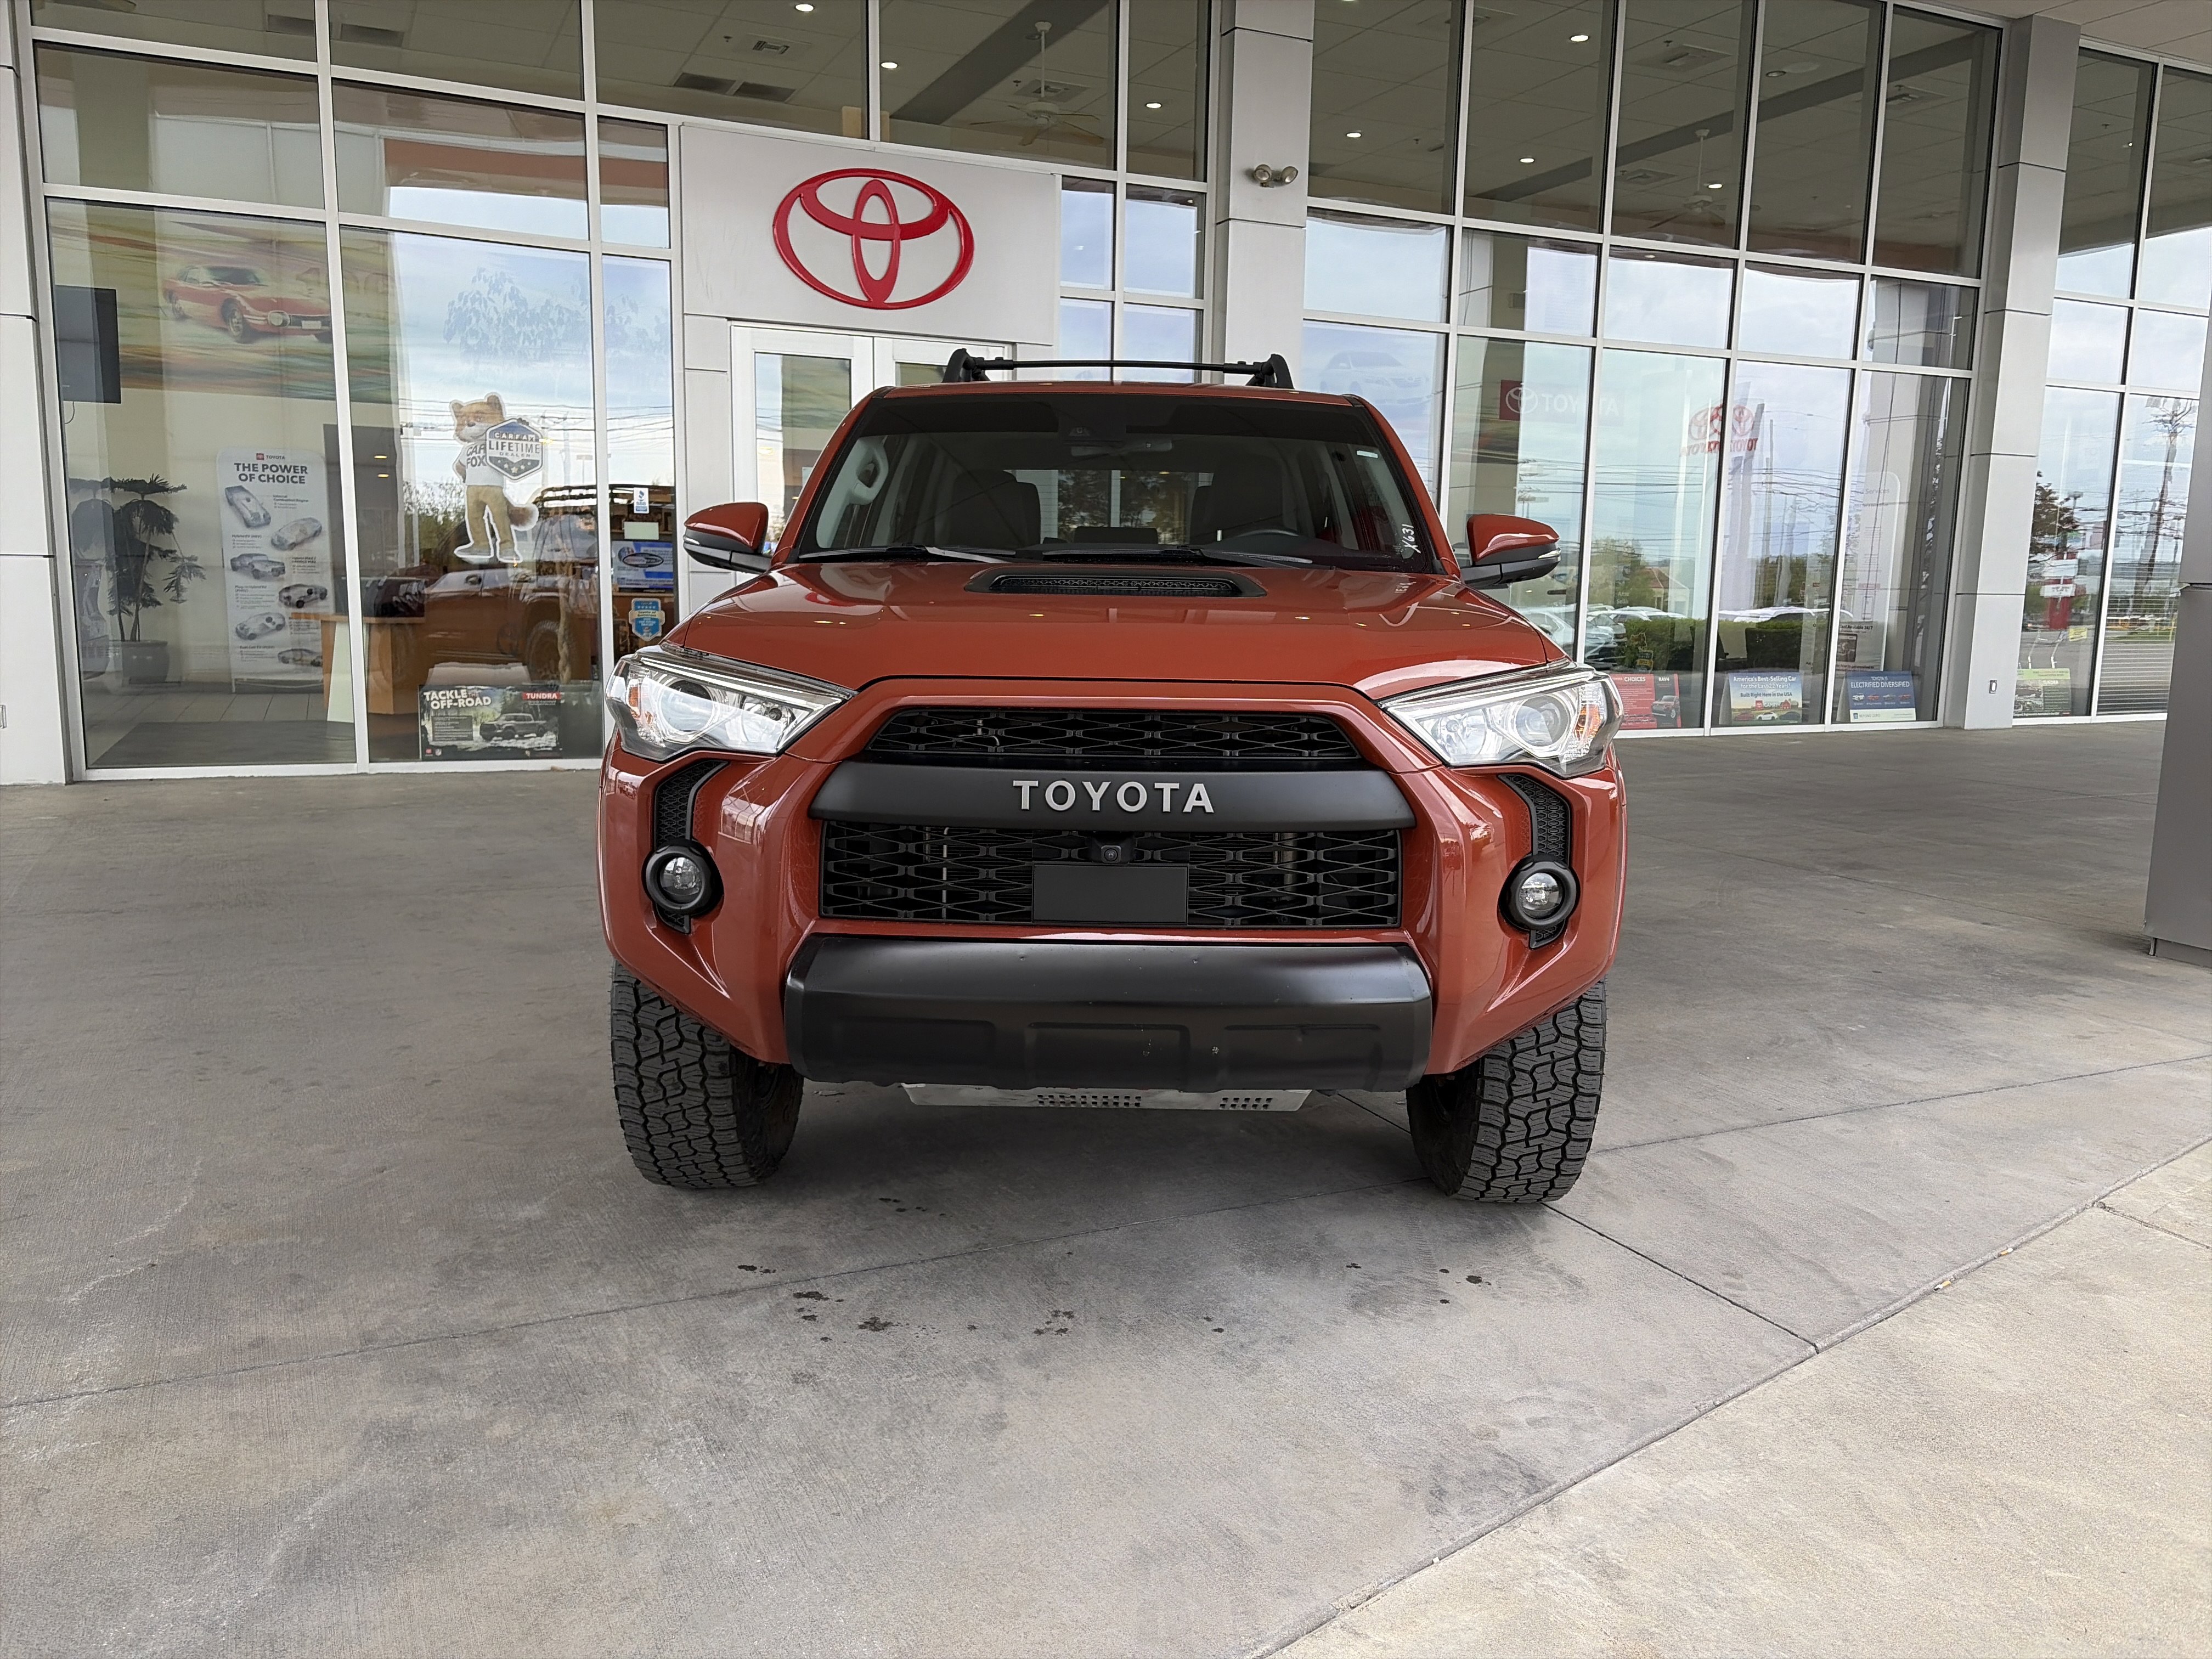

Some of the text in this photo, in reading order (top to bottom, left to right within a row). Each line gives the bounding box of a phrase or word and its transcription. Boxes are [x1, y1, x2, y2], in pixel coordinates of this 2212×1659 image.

[494, 432, 535, 442] CARFAX
[488, 441, 540, 454] LIFETIME
[234, 462, 308, 475] THE POWER
[466, 455, 487, 469] FOX
[238, 473, 306, 484] OF CHOICE
[1402, 523, 1421, 554] X631
[423, 689, 467, 702] TACKLE
[430, 696, 492, 710] OFF-ROAD
[1013, 780, 1214, 813] TOYOTA
